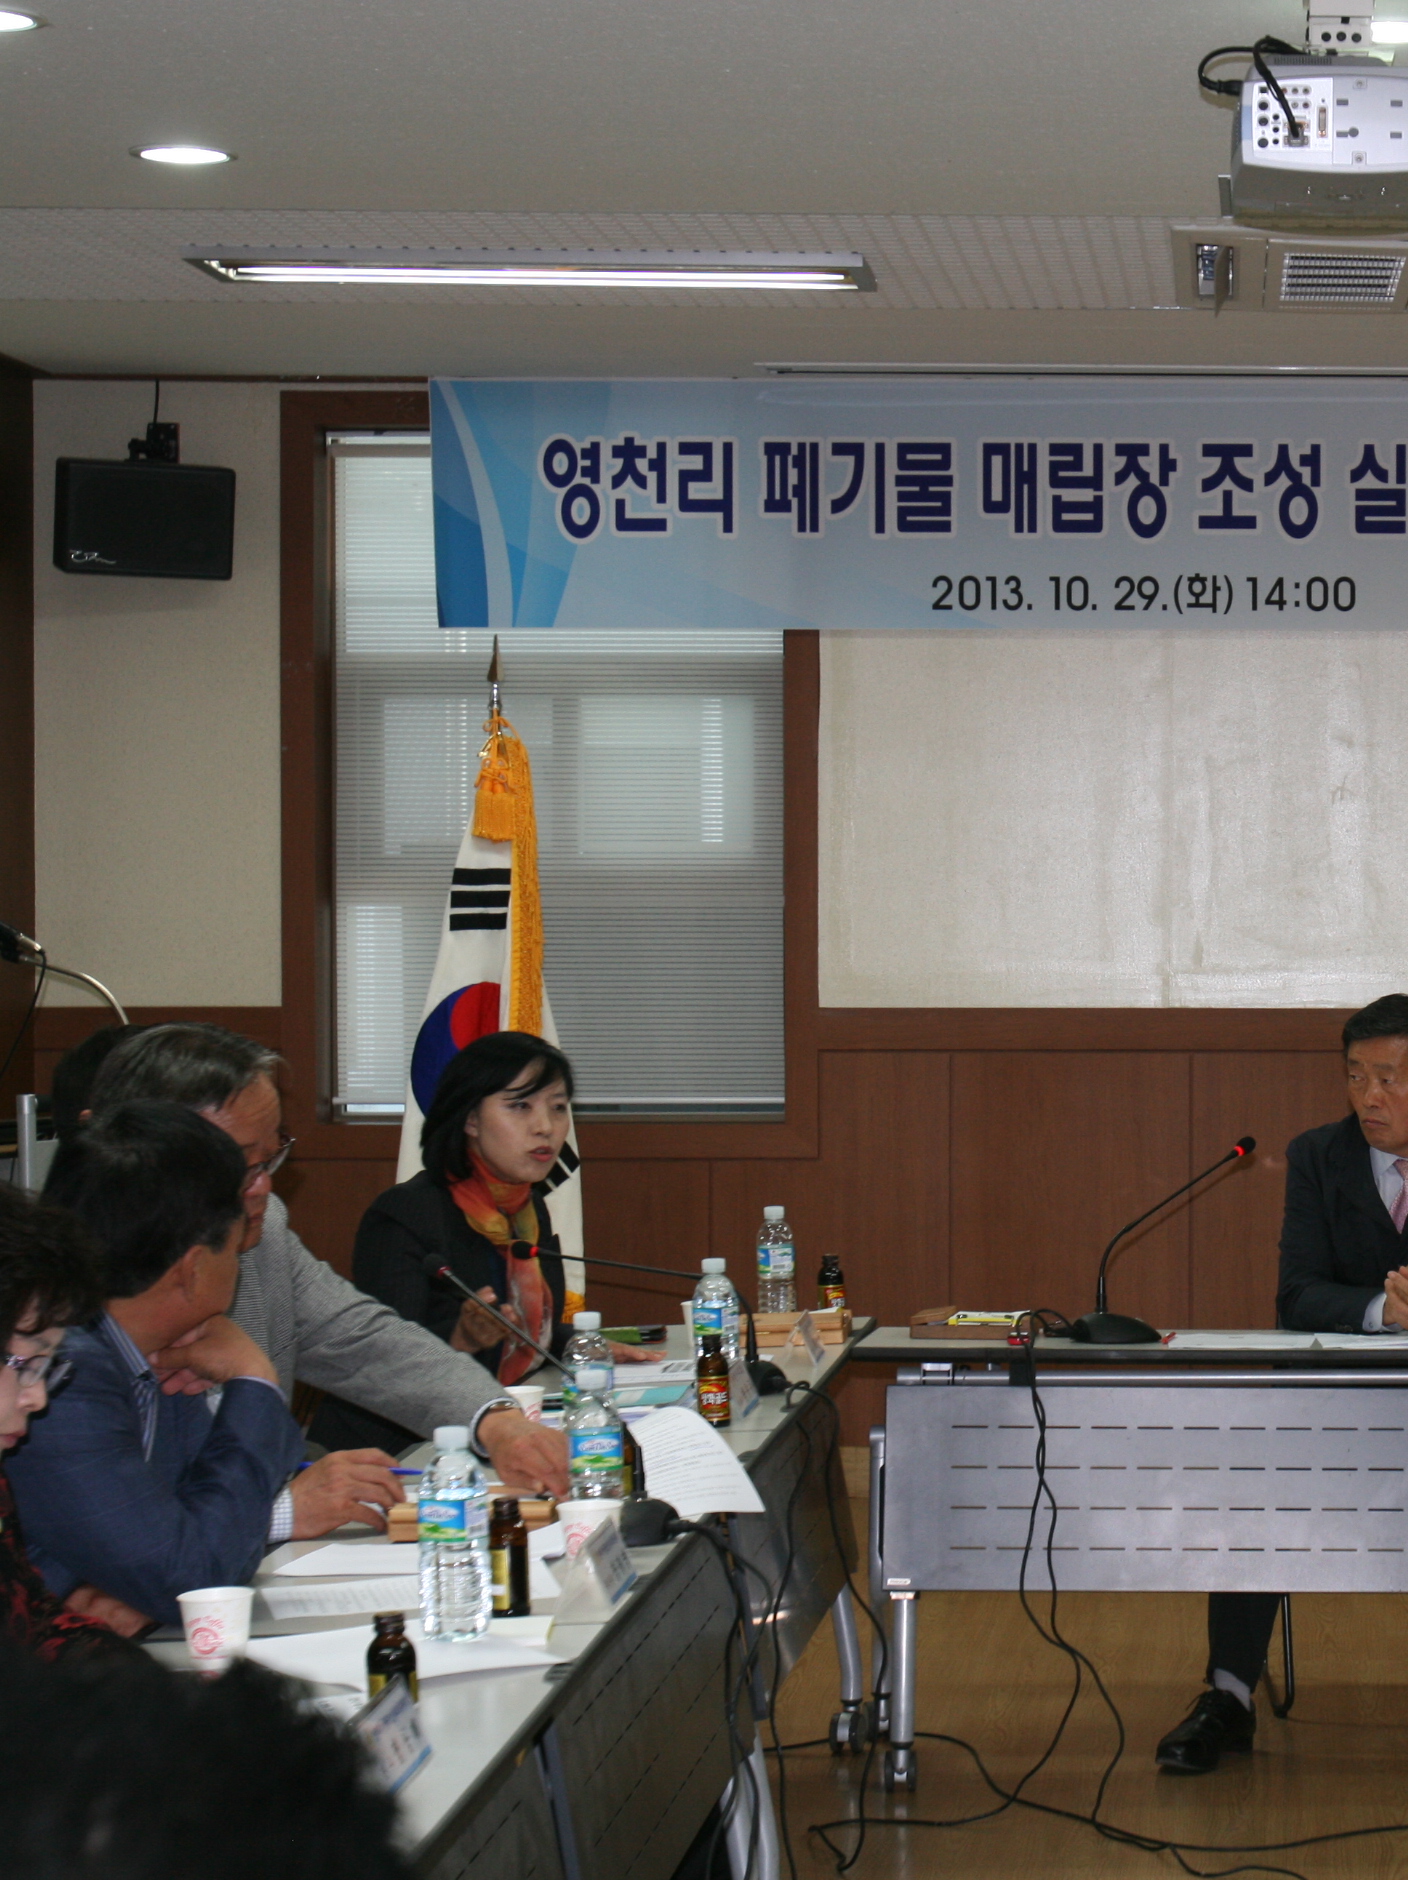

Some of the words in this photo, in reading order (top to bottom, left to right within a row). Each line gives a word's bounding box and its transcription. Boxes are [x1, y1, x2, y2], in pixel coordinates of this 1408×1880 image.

[542, 438, 735, 539] 영천리
[763, 441, 954, 534] 폐기물
[982, 441, 1178, 539] 매립장
[1198, 442, 1321, 540] 조성
[931, 574, 1033, 611] 2013.
[1048, 575, 1098, 612] 10.
[1246, 576, 1357, 612] 14:00
